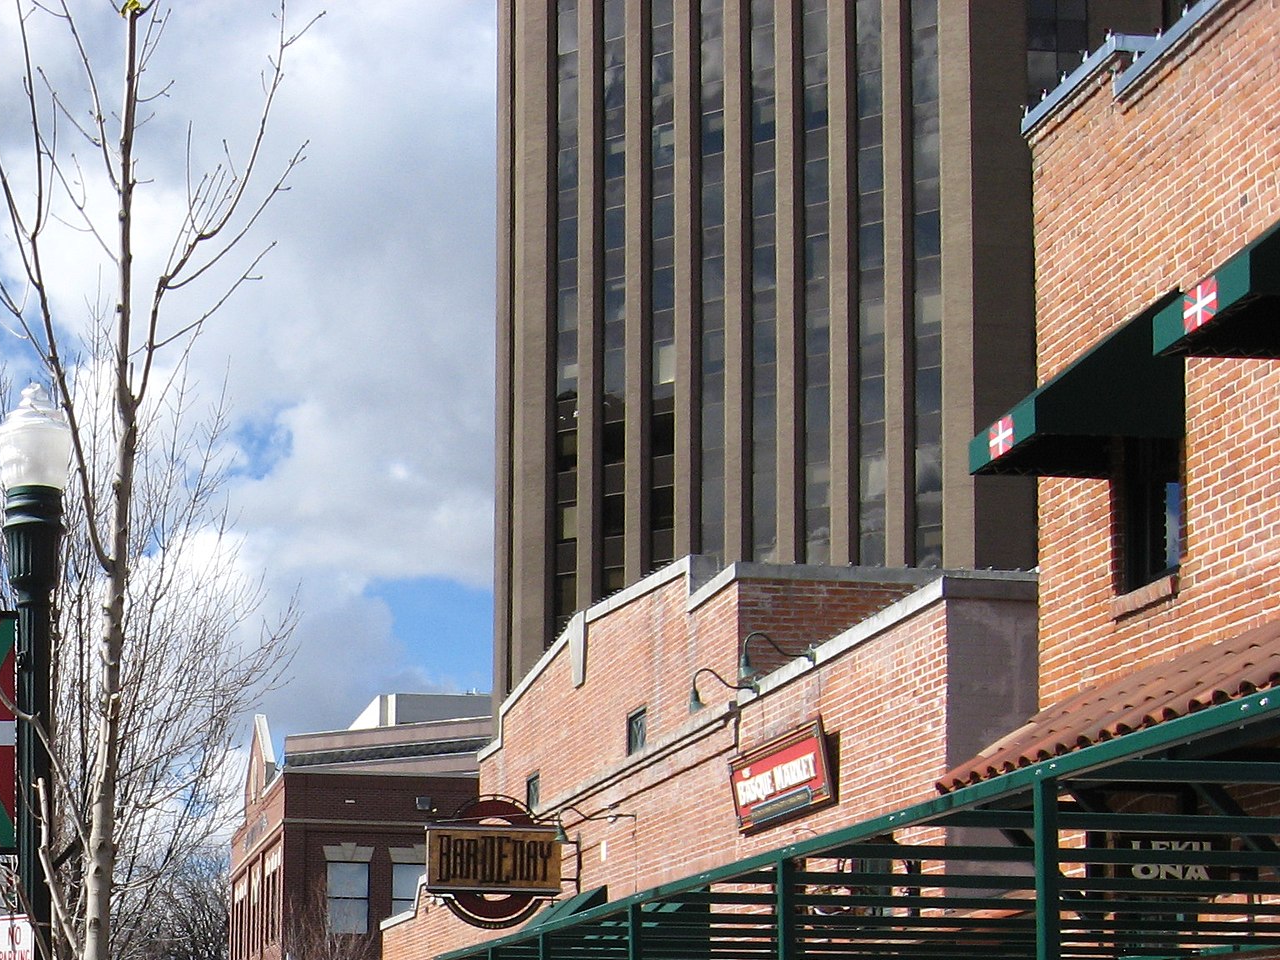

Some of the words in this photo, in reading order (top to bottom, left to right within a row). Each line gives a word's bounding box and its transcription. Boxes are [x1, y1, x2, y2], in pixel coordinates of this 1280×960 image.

[736, 770, 774, 806] BASQUE
[773, 752, 816, 790] MARKET
[437, 835, 553, 883] BARDENAY
[1131, 864, 1210, 880] ONA
[7, 926, 22, 946] NO
